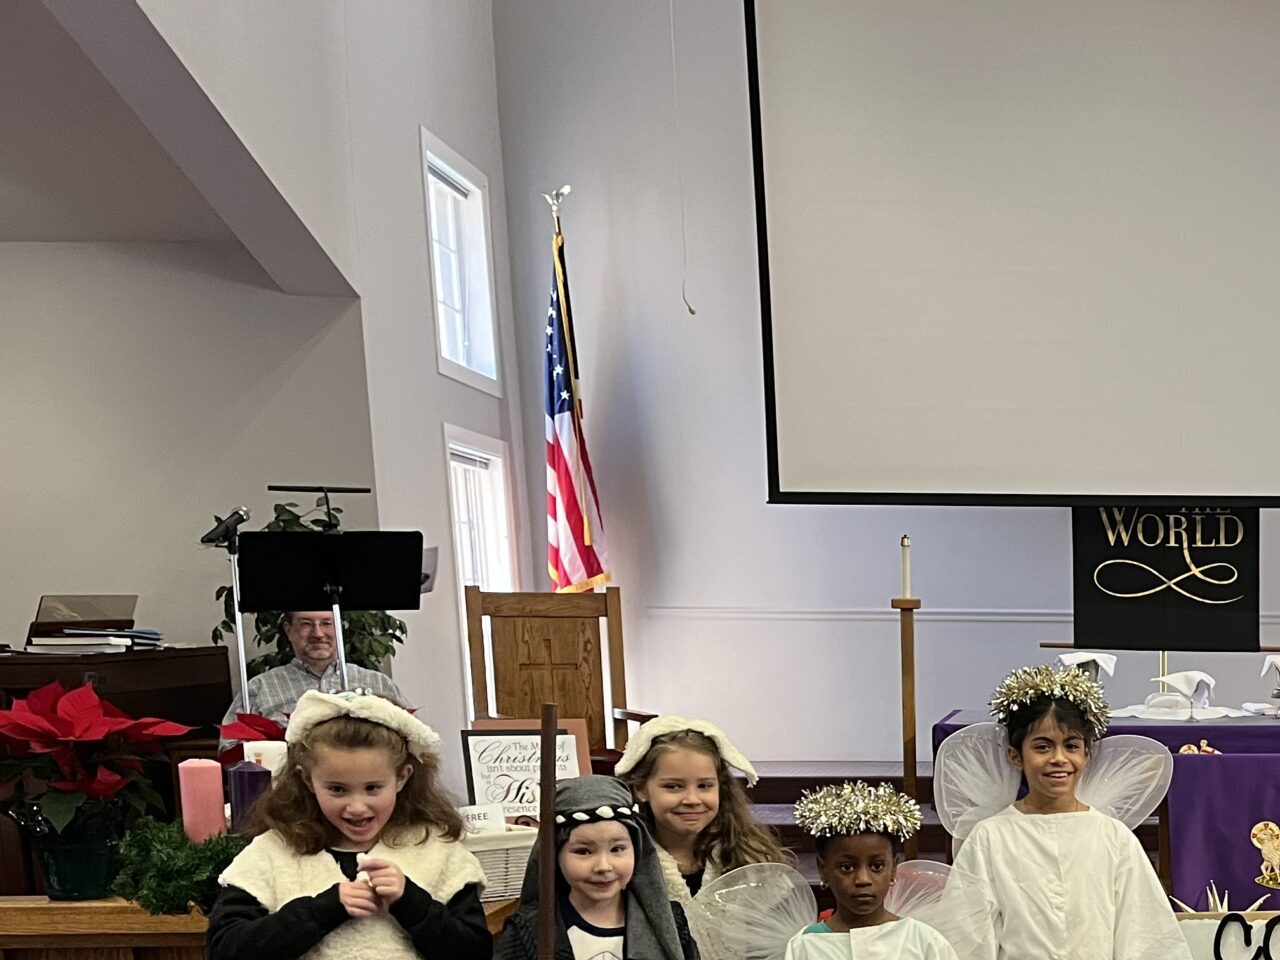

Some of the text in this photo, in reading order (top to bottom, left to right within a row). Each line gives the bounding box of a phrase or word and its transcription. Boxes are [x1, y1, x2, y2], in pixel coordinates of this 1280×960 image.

[1099, 507, 1245, 560] WORLD
[512, 742, 528, 751] The
[505, 764, 531, 773] about
[503, 805, 538, 813] resence
[466, 812, 489, 822] FREE
